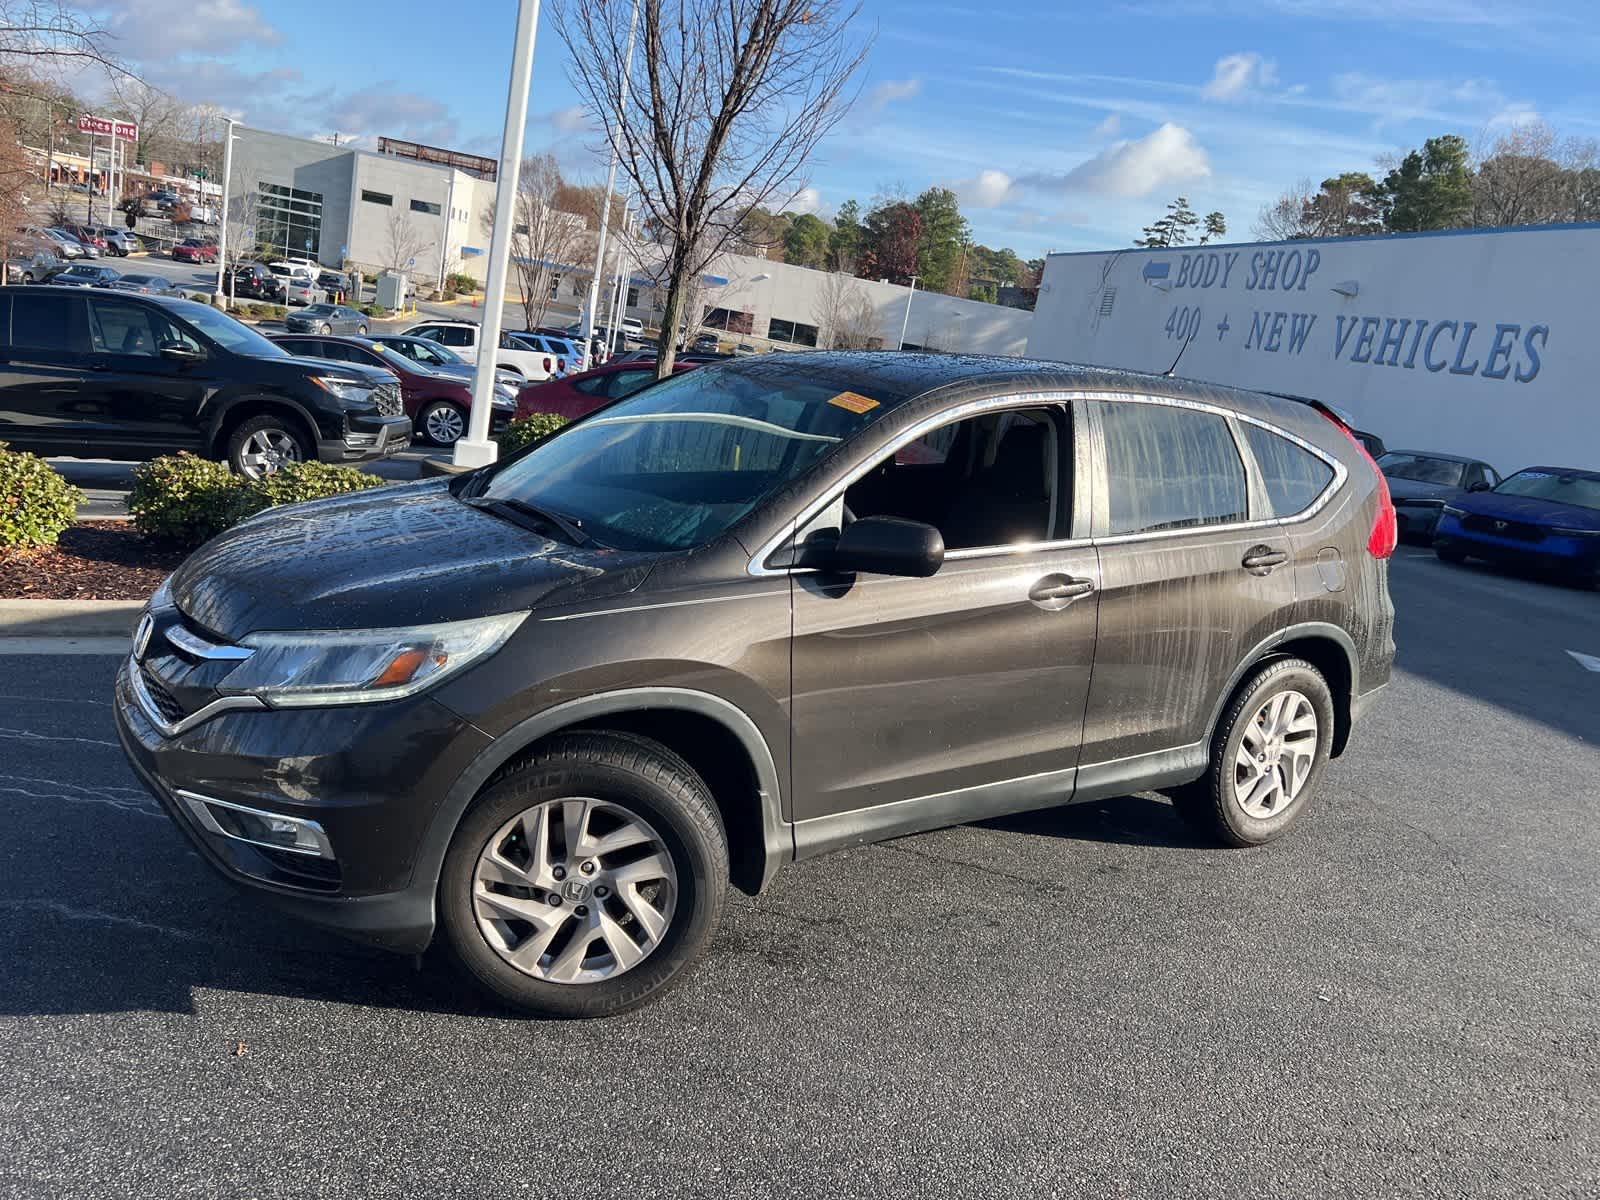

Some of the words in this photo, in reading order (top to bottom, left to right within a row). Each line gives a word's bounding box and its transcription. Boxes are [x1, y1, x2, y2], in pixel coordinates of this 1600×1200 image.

[1175, 253, 1239, 289] BODY
[1245, 249, 1321, 290] SHOP
[1165, 306, 1201, 341] 400
[1217, 313, 1230, 341] +
[1244, 311, 1318, 354] NEW
[1335, 315, 1549, 383] VEHICLES
